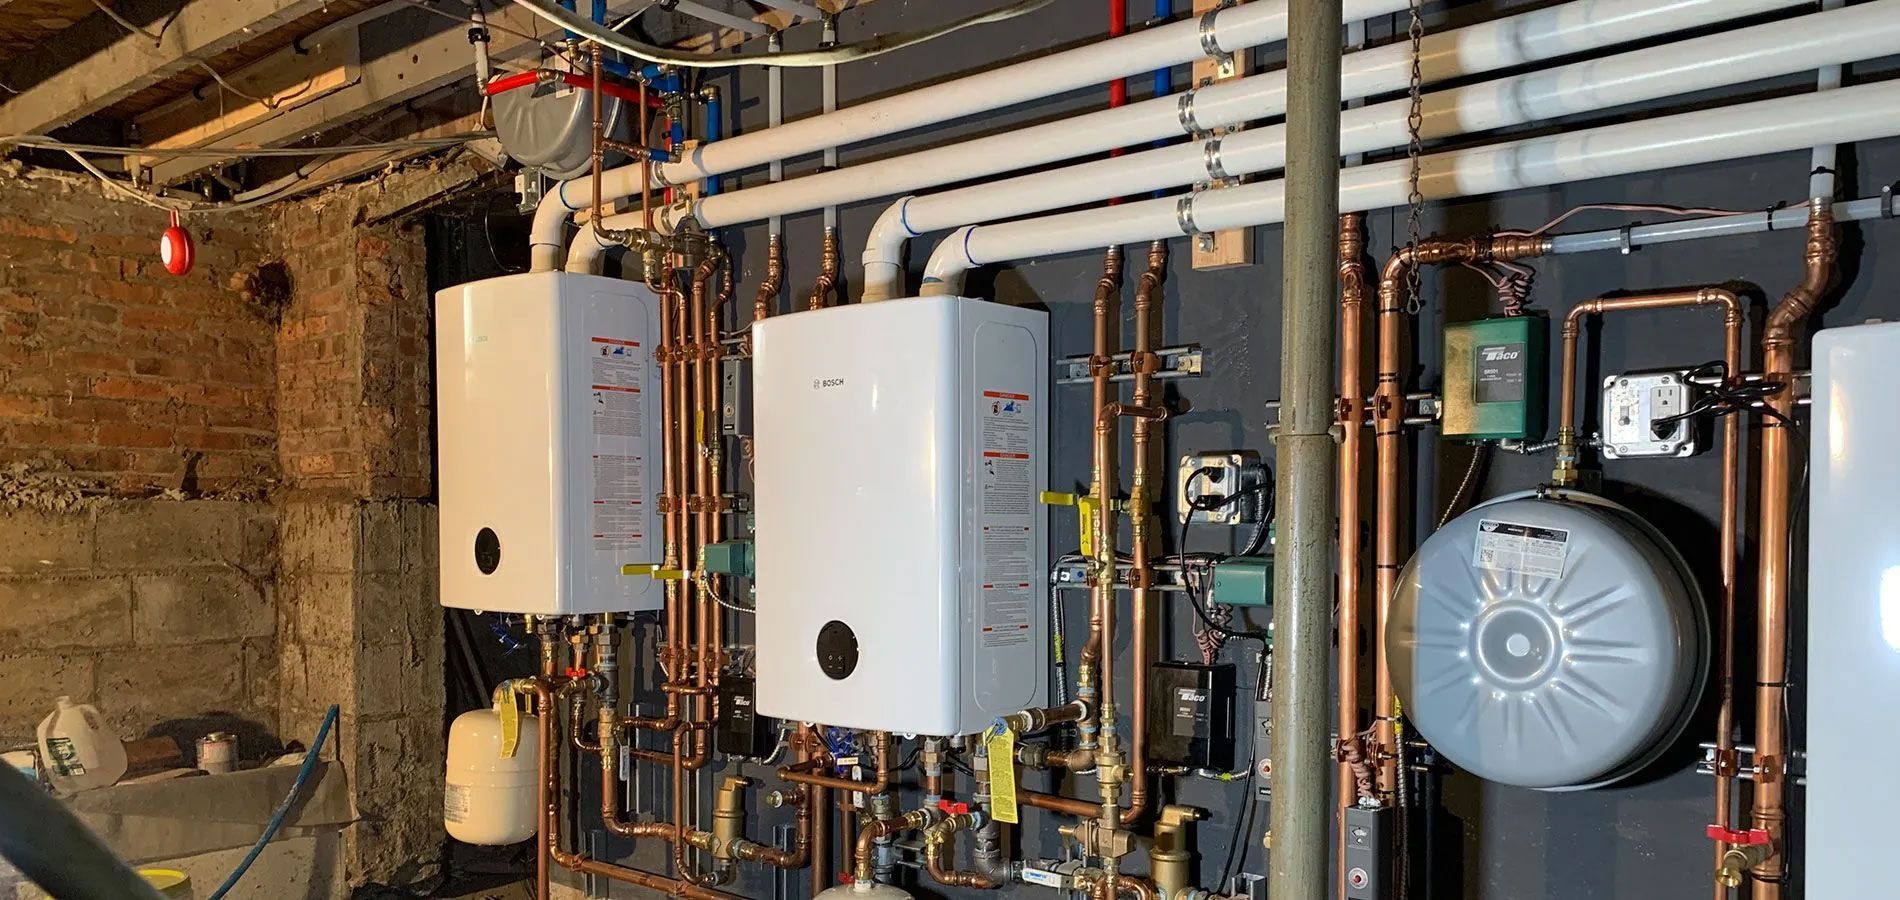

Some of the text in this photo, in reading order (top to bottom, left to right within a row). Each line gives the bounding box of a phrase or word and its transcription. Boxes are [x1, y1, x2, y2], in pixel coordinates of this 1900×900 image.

[1481, 347, 1519, 361] Taco
[823, 379, 844, 387] BOSCH
[1178, 689, 1206, 702] Taco
